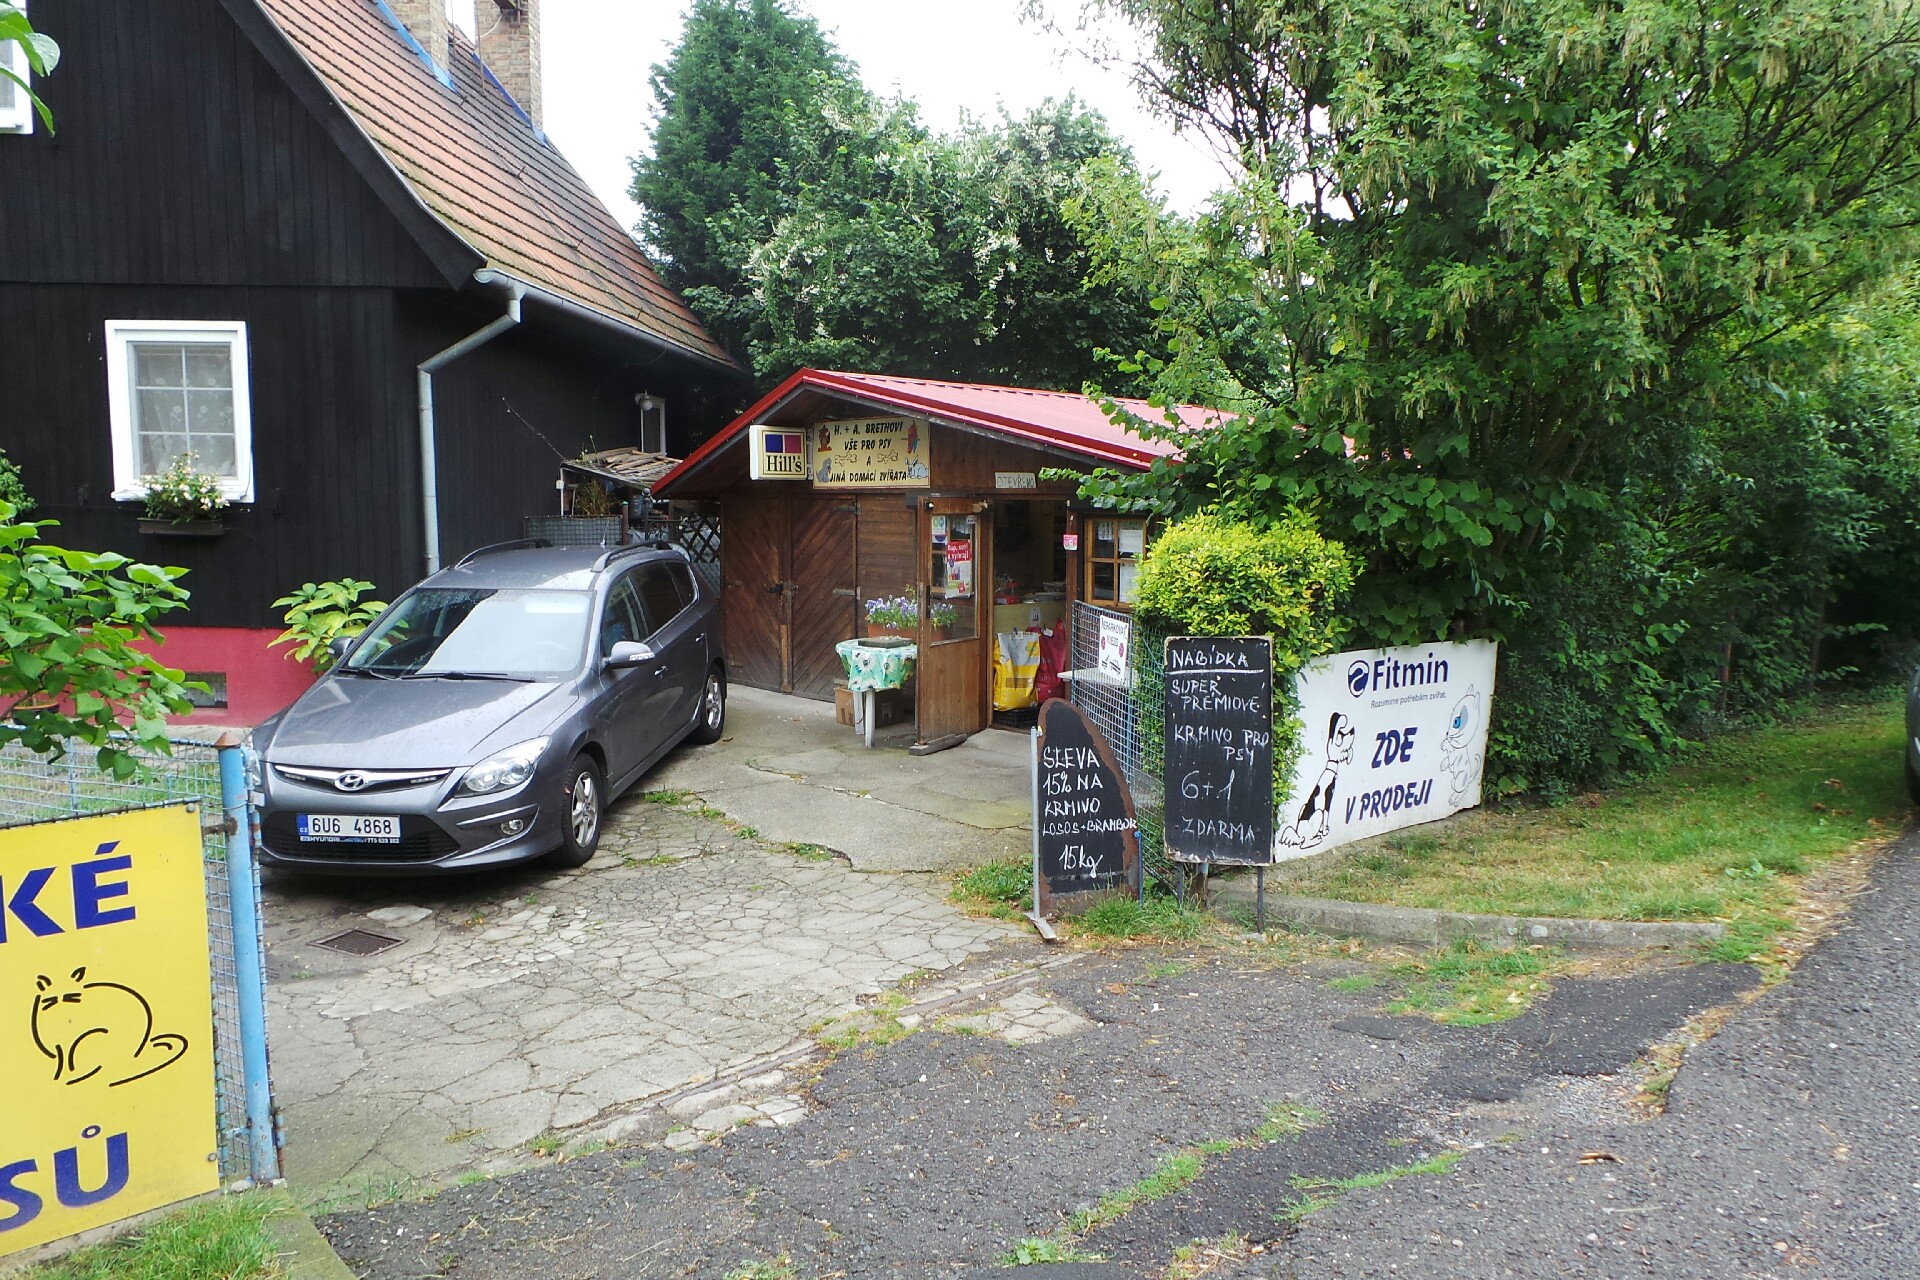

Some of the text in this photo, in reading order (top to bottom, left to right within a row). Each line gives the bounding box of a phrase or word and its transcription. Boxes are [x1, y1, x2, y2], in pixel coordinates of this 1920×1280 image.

[834, 426, 842, 435] H.
[853, 425, 860, 435] A.
[844, 438, 892, 450] VŠE PRO PSY
[766, 455, 803, 472] Hill's
[866, 457, 871, 466] A
[830, 469, 907, 482] JINÁ DOMÁCÍ ZVÍŘATA
[1172, 644, 1248, 669] NABÍDKA
[1372, 652, 1448, 691] Fitmin
[1171, 679, 1221, 695] SUPER
[1174, 723, 1269, 746] KRMIVO PRO
[1043, 746, 1100, 770] SLEVA
[1221, 746, 1254, 767] PSY
[1371, 727, 1418, 769] ZDE
[1043, 771, 1103, 796] 15% NA
[1044, 797, 1100, 817] KRMIVO
[1345, 778, 1433, 824] V PRODEJI
[312, 817, 392, 834] 6U6 4868
[1181, 816, 1255, 844] ZDARMA
